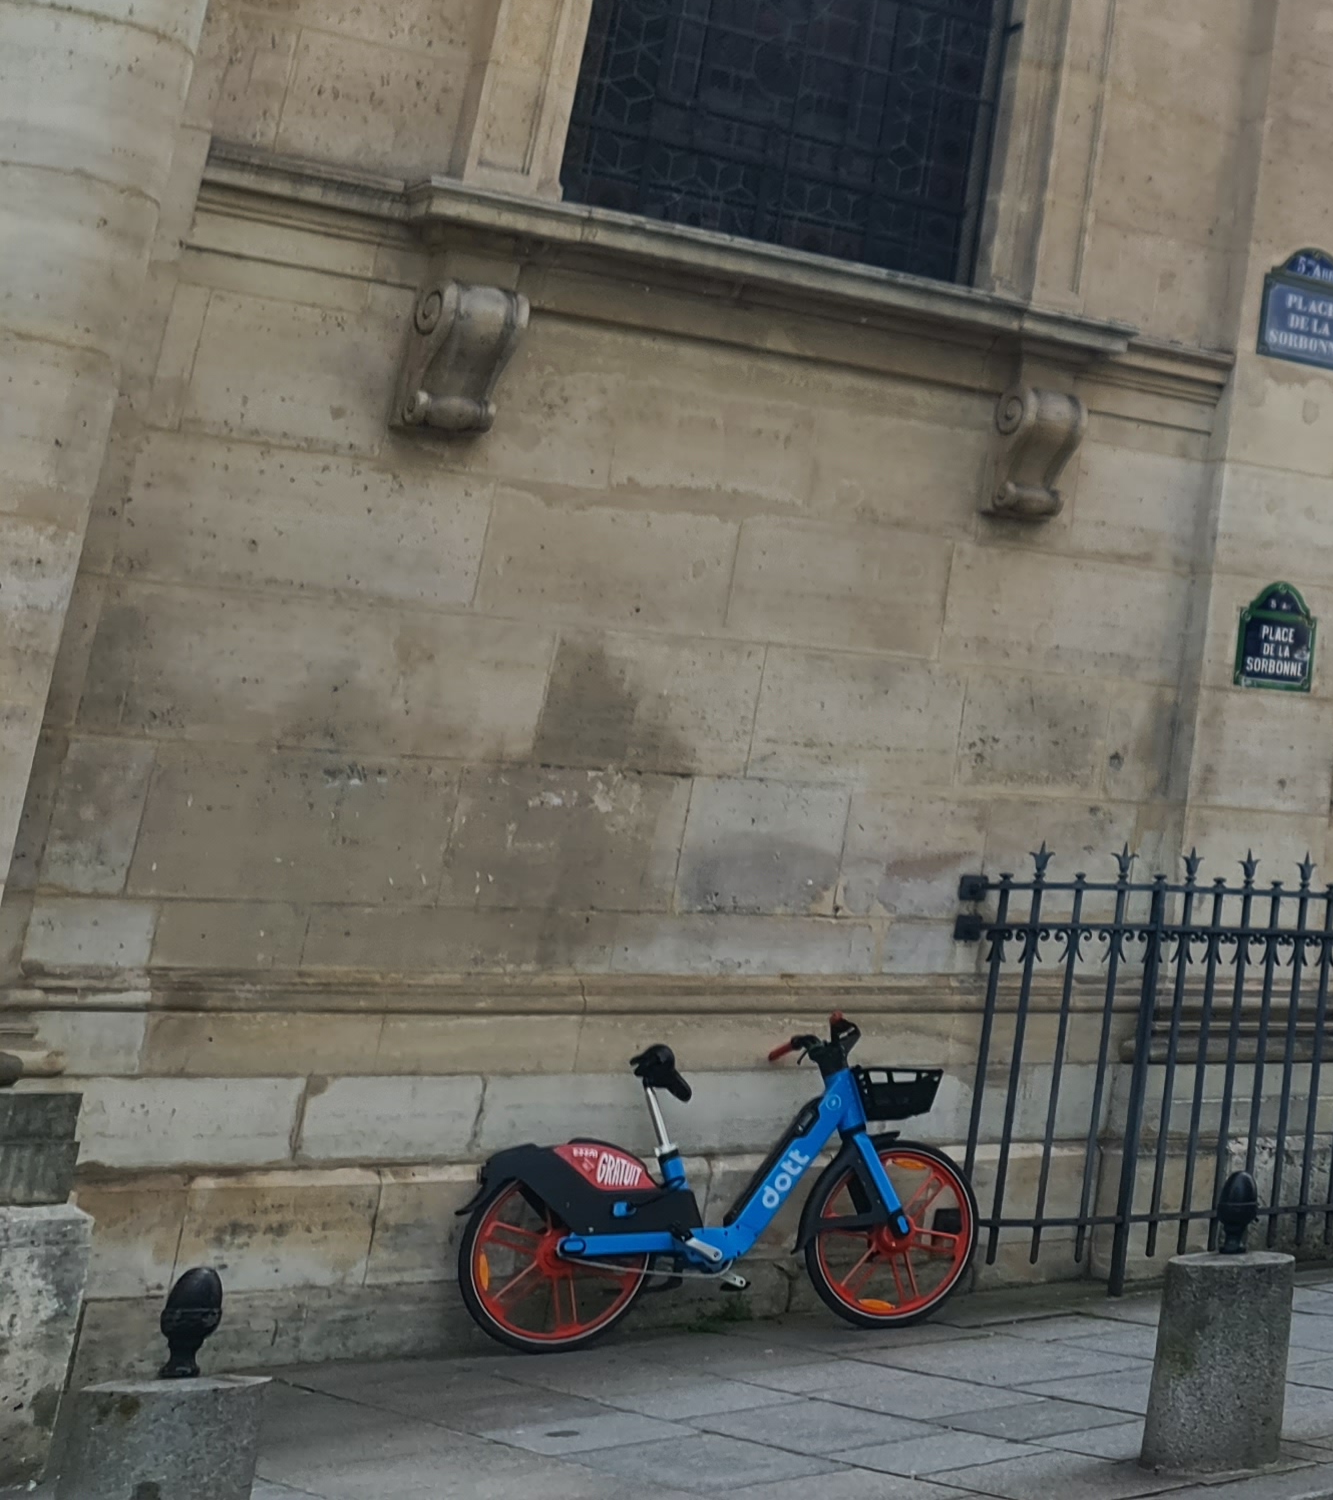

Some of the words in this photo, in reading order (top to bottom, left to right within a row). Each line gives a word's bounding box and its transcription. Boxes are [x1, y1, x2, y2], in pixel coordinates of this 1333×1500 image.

[1289, 313, 1309, 332] DE
[1313, 319, 1330, 336] LA
[1262, 625, 1294, 643] PLACE
[1263, 643, 1275, 656] DE
[1278, 645, 1290, 658] LA
[1246, 657, 1302, 676] SORBONNE
[596, 1152, 642, 1187] GRATUIT
[762, 1148, 810, 1209] dott
